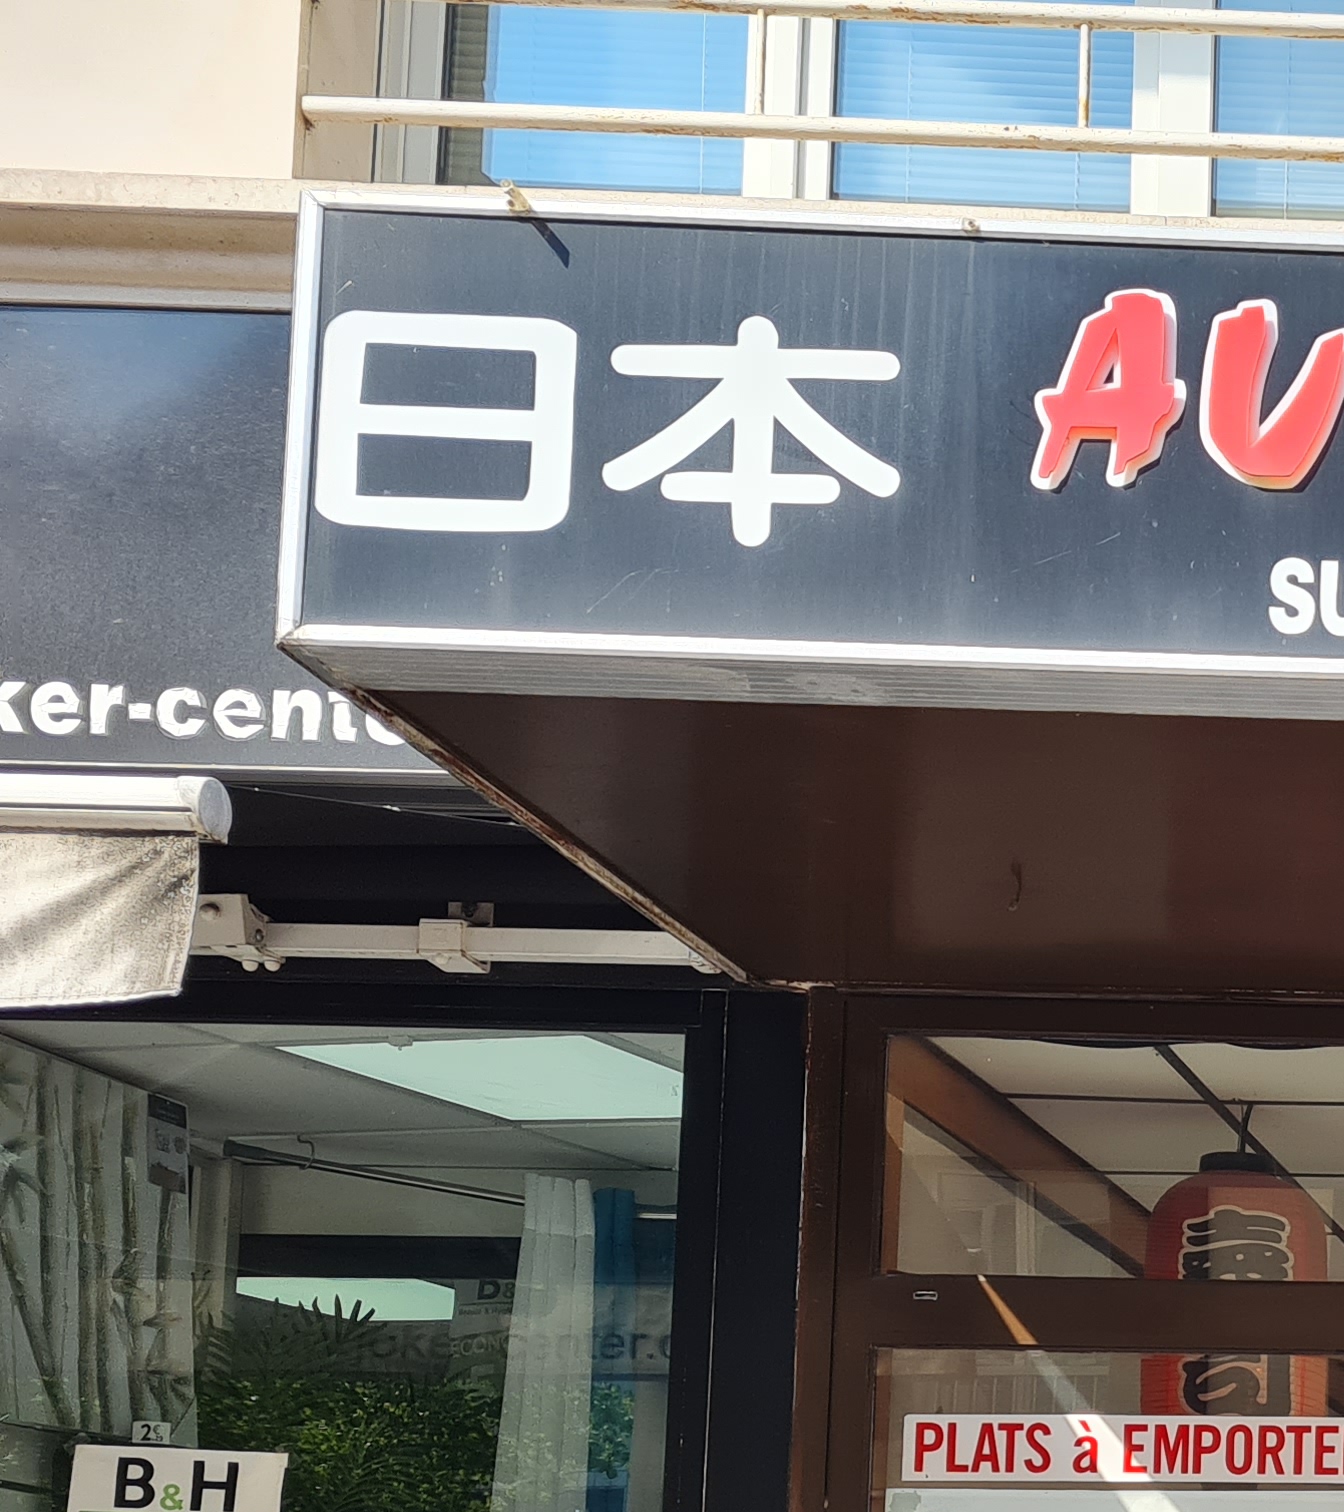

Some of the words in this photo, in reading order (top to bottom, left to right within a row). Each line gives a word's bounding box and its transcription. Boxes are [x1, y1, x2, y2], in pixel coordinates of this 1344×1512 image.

[315, 310, 901, 547] 日本
[914, 1421, 1052, 1474] PLATS
[1072, 1420, 1100, 1475] à
[113, 1456, 240, 1512] B&H
